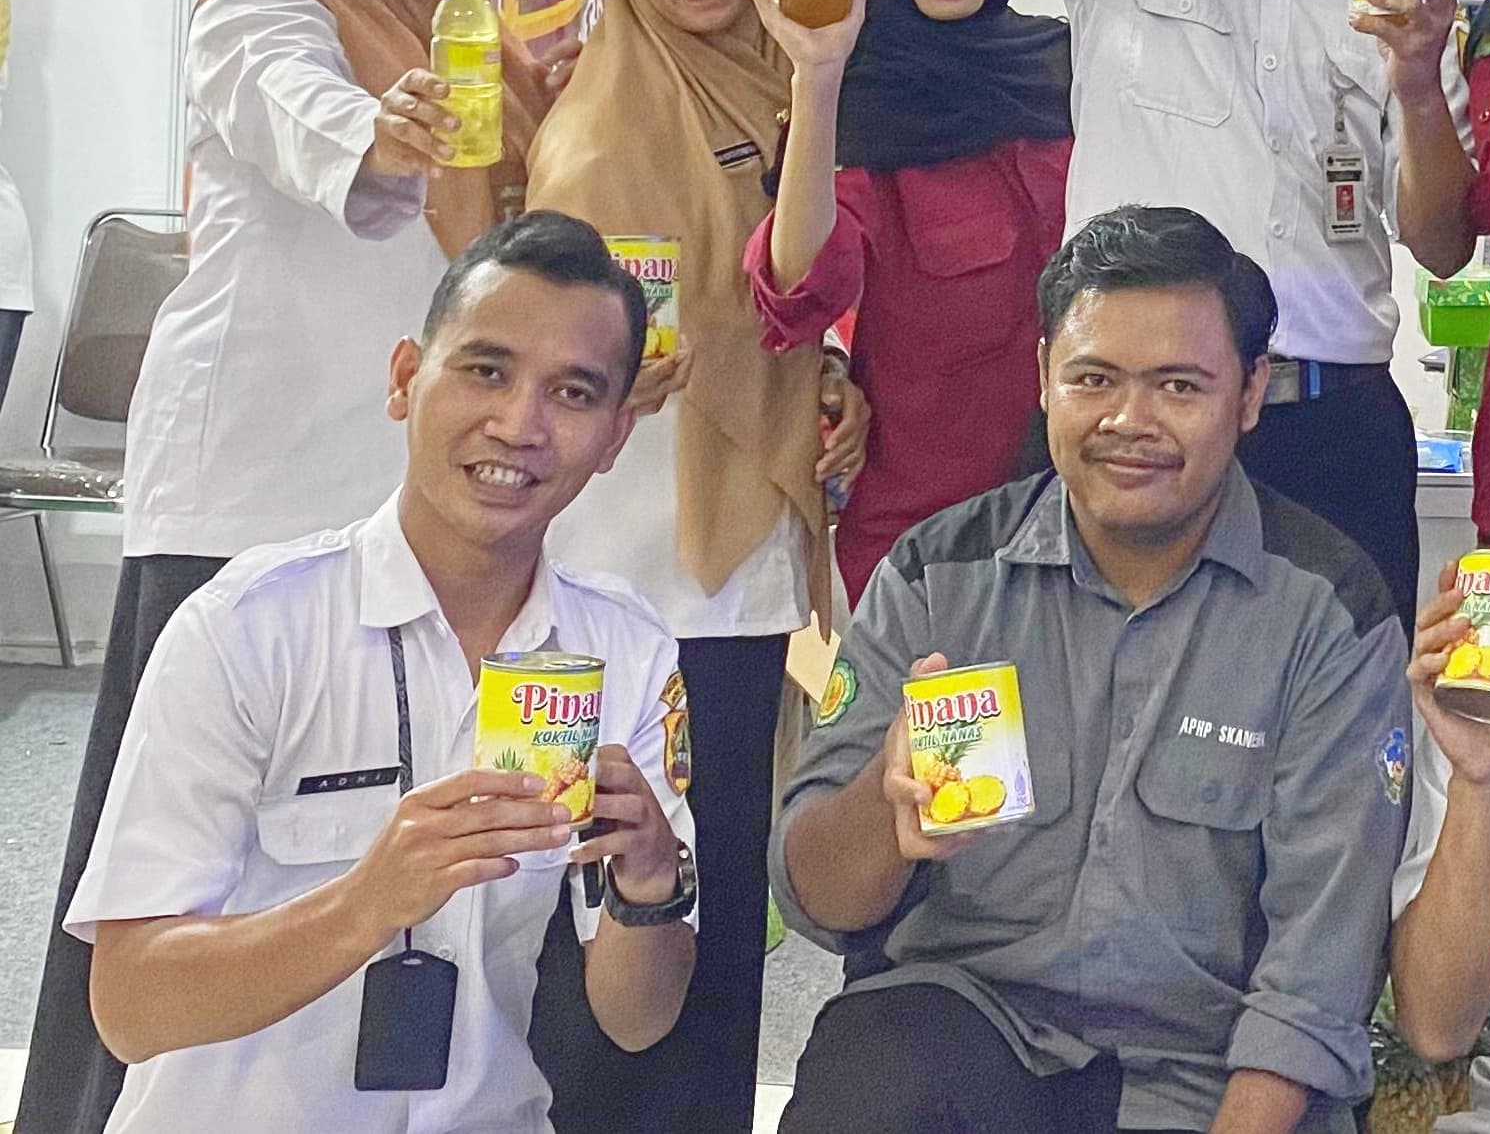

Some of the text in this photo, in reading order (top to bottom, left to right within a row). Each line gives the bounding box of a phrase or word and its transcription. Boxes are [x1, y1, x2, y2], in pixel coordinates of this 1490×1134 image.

[512, 683, 601, 727] Pina
[531, 729, 579, 746] KOKTIL
[941, 724, 984, 744] NANAS
[1178, 715, 1213, 739] APHP
